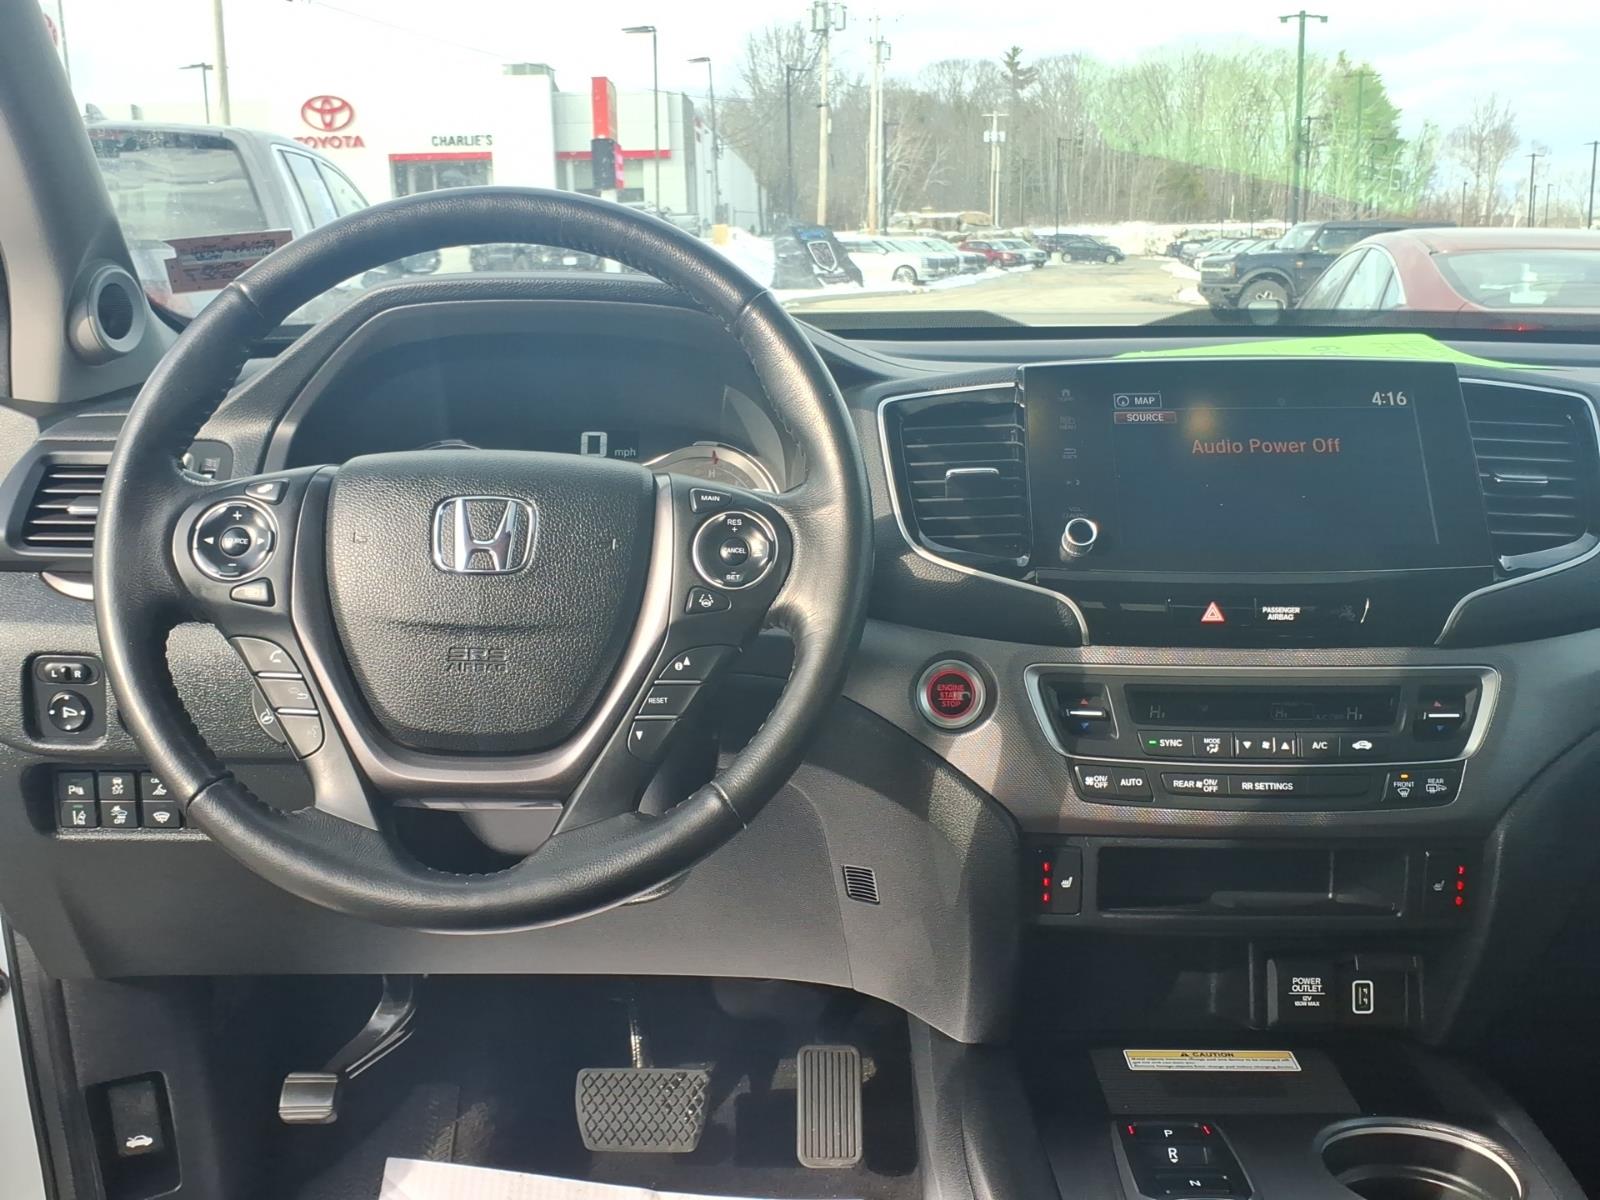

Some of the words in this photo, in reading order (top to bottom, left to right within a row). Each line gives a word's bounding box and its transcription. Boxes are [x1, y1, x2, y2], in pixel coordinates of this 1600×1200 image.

[431, 135, 493, 146] CHARLIE'S
[1134, 396, 1156, 405] MAP
[1371, 391, 1407, 406] 4:16
[1126, 413, 1164, 422] SOURCE
[580, 431, 608, 457] 0
[1191, 439, 1244, 454] Audio
[1249, 439, 1306, 454] Power
[1312, 438, 1341, 453] Off
[614, 447, 636, 457] mph
[74, 670, 82, 678] R
[1160, 739, 1183, 747] SYNC
[1312, 741, 1328, 750] A/C
[1120, 778, 1142, 786] AUTO
[1173, 780, 1194, 788] REAR
[1242, 782, 1253, 791] RR
[1254, 782, 1294, 791] SETTINGS
[1292, 977, 1321, 985] POWER
[1164, 1129, 1173, 1138] P
[1168, 1147, 1178, 1159] R
